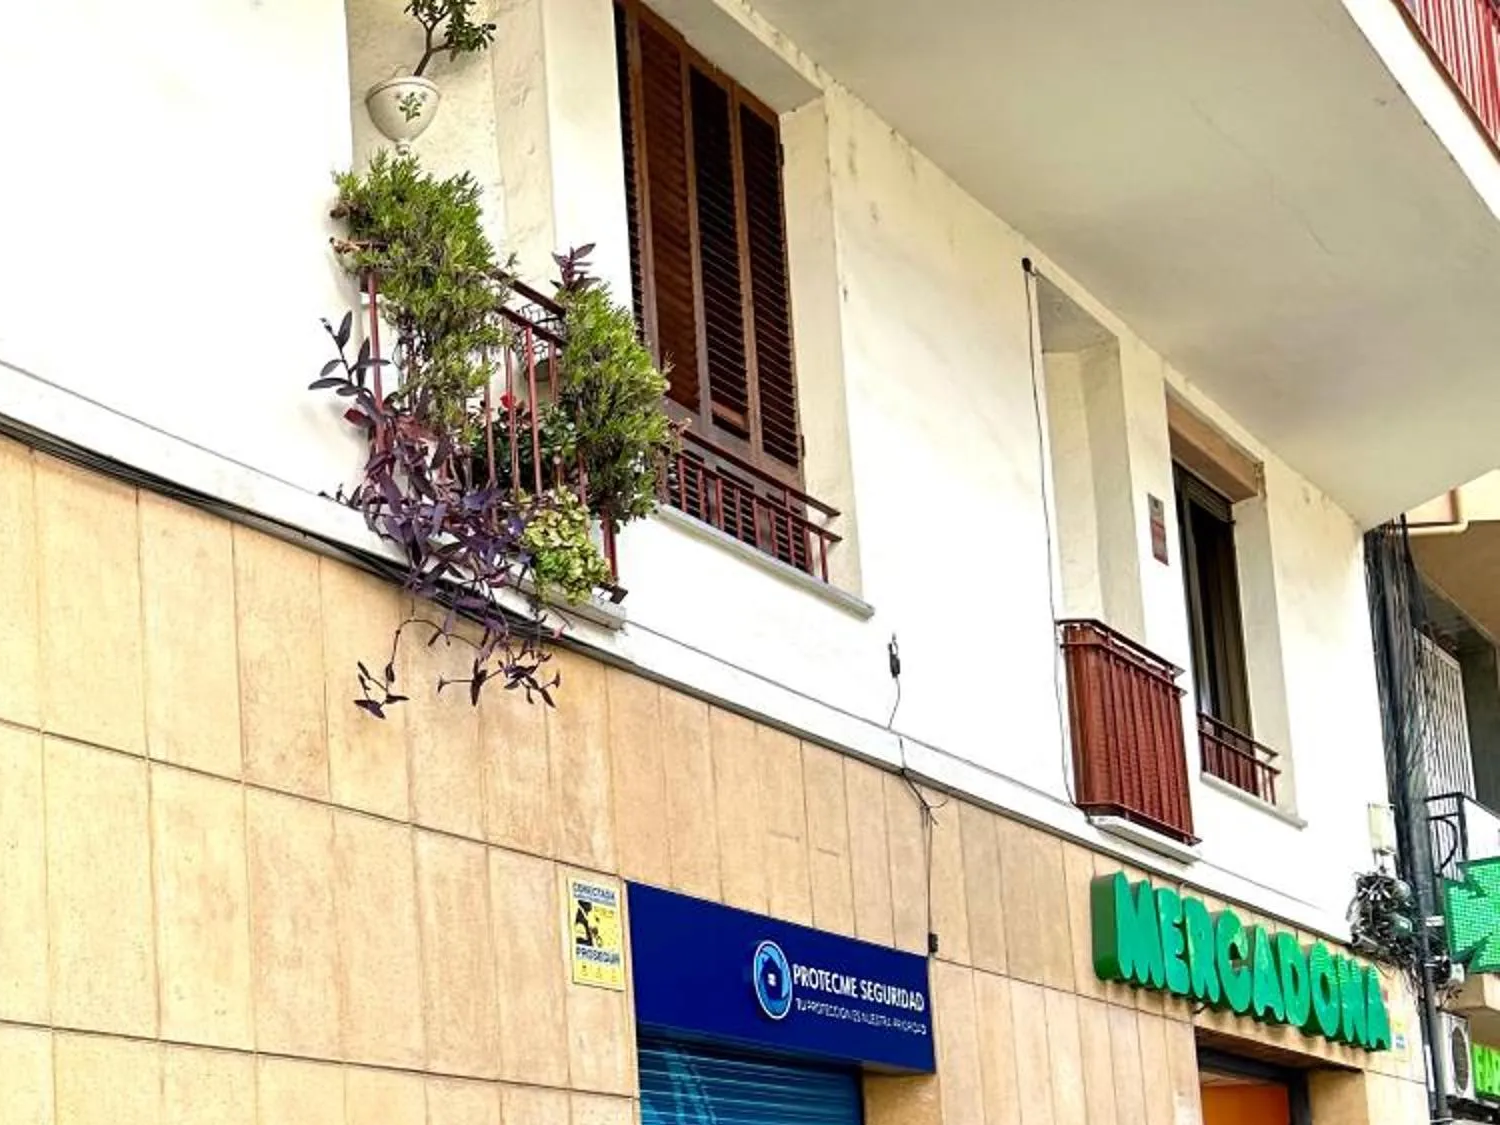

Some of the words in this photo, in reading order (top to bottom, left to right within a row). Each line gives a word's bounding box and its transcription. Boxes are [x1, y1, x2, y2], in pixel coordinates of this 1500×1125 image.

[792, 963, 859, 998] PROTECME
[859, 979, 925, 1012] SEGURIDAD
[1111, 870, 1391, 1052] MERCADONA
